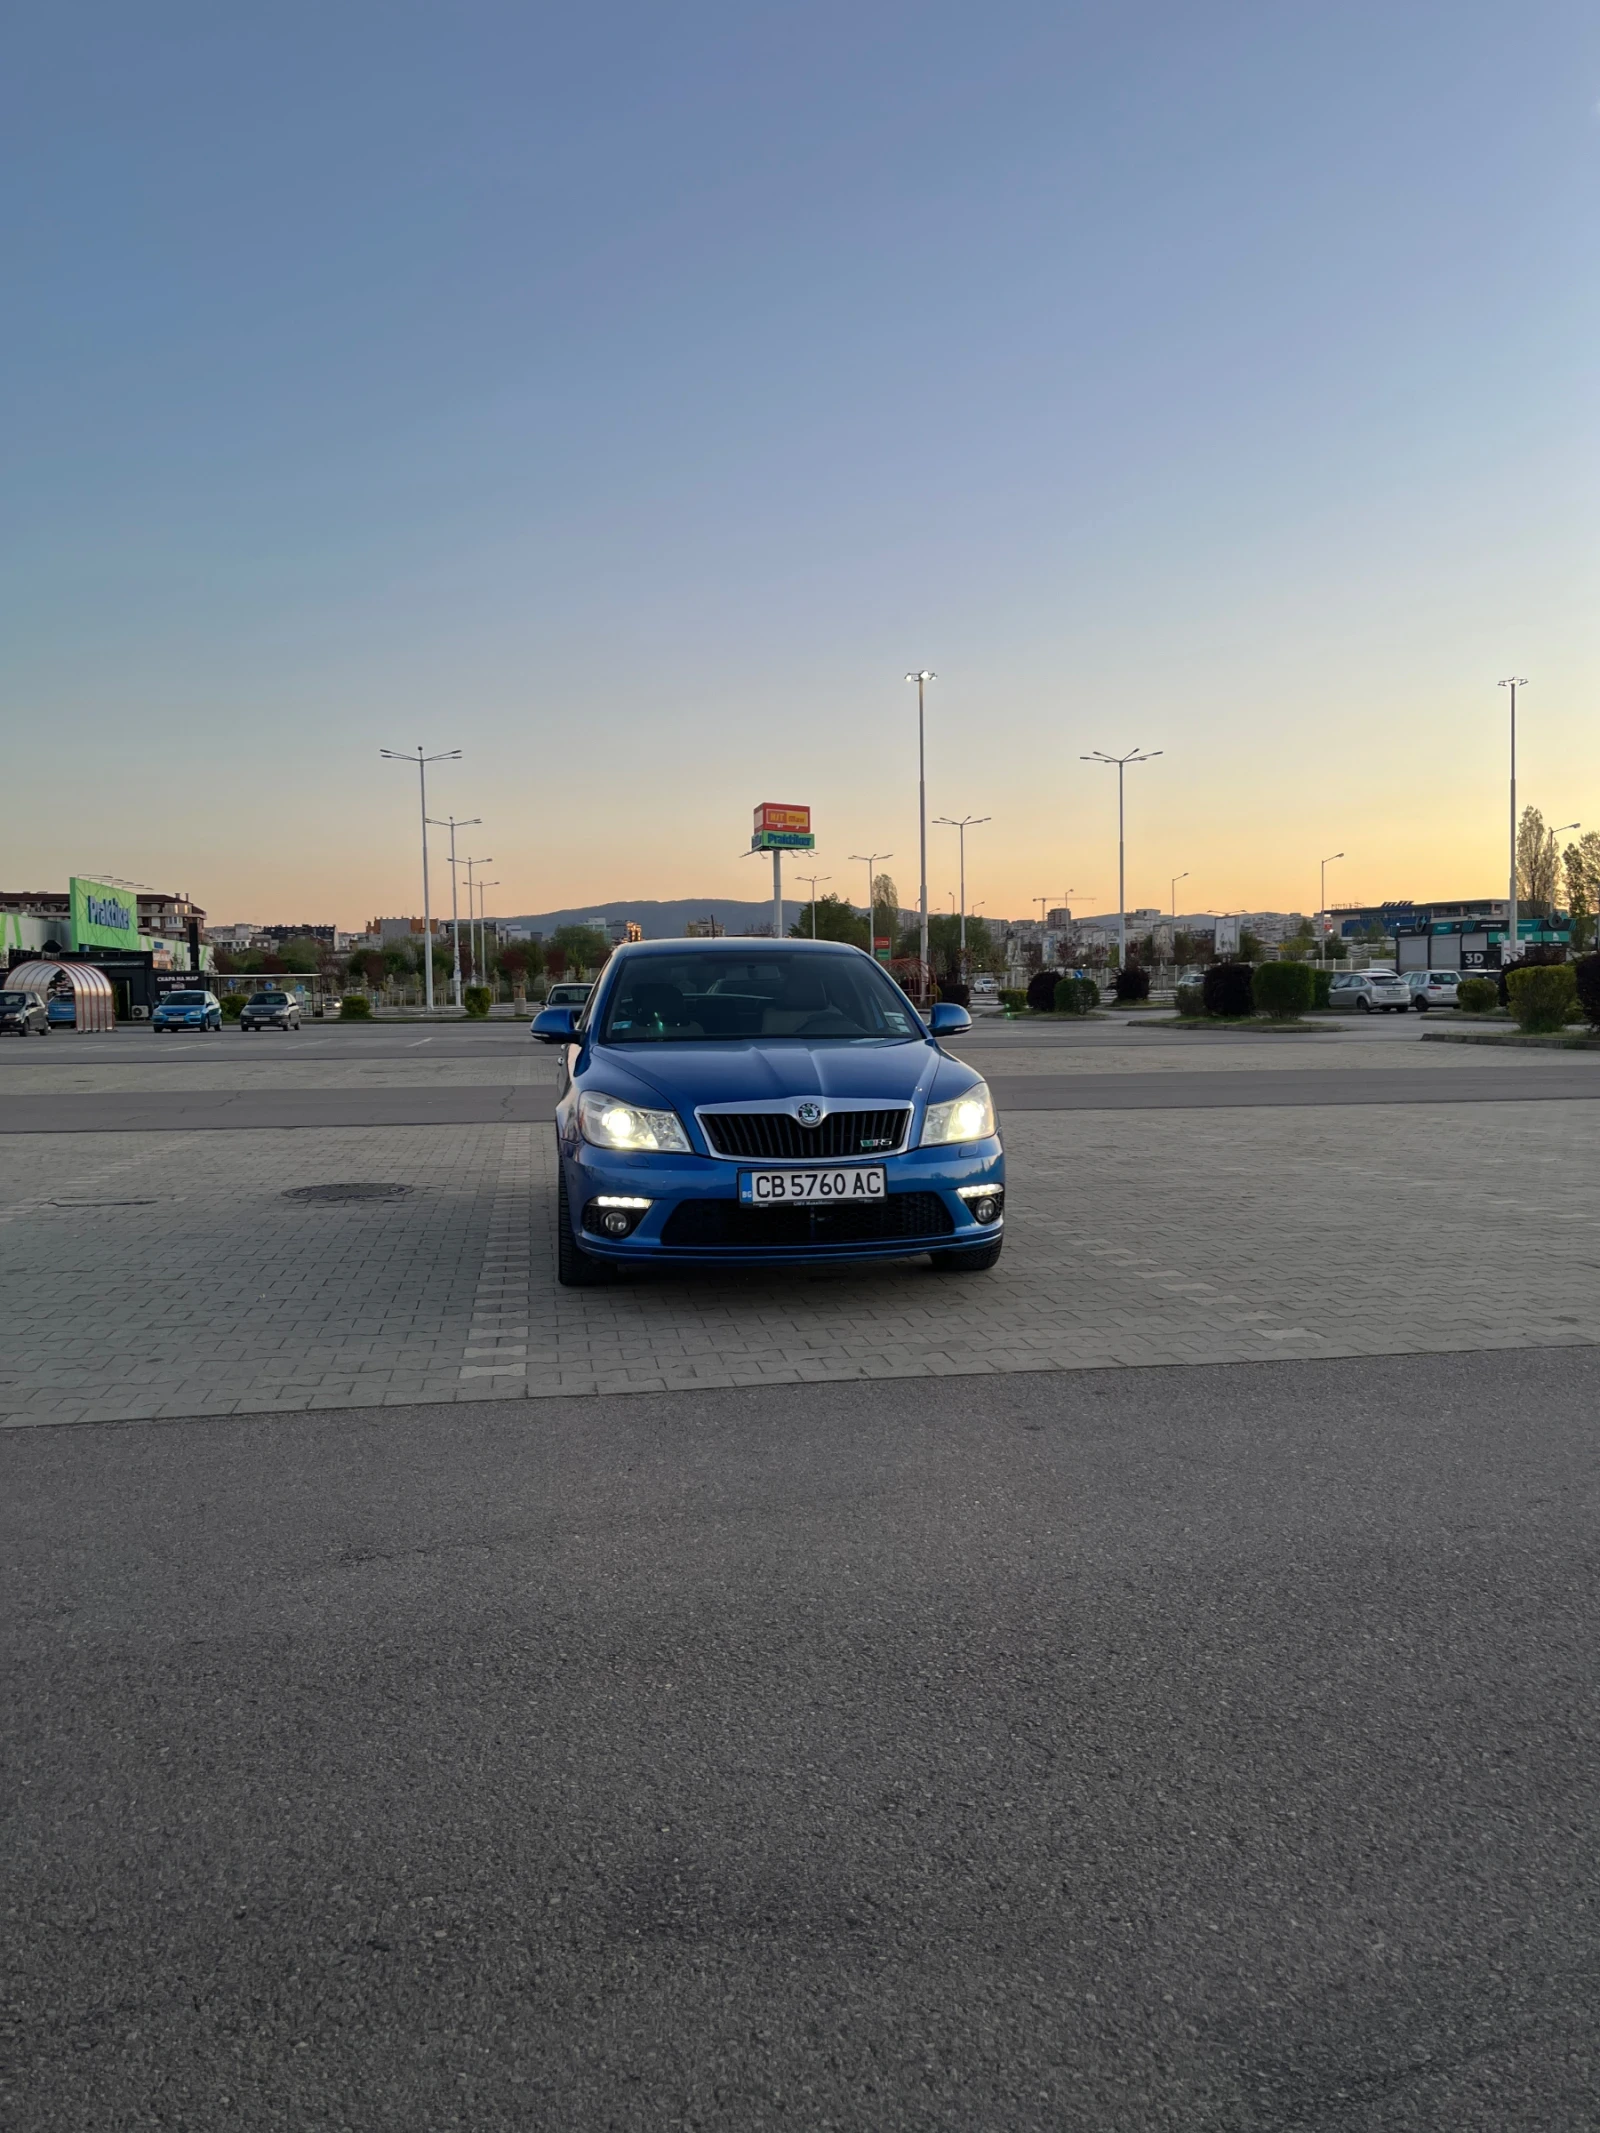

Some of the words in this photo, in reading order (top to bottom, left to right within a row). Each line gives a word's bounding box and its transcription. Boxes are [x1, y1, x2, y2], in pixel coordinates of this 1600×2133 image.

[1465, 953, 1484, 964] 3D
[742, 1190, 752, 1198] BG
[756, 1175, 786, 1199] CB
[791, 1173, 846, 1197] 5760
[852, 1171, 881, 1195] AC
